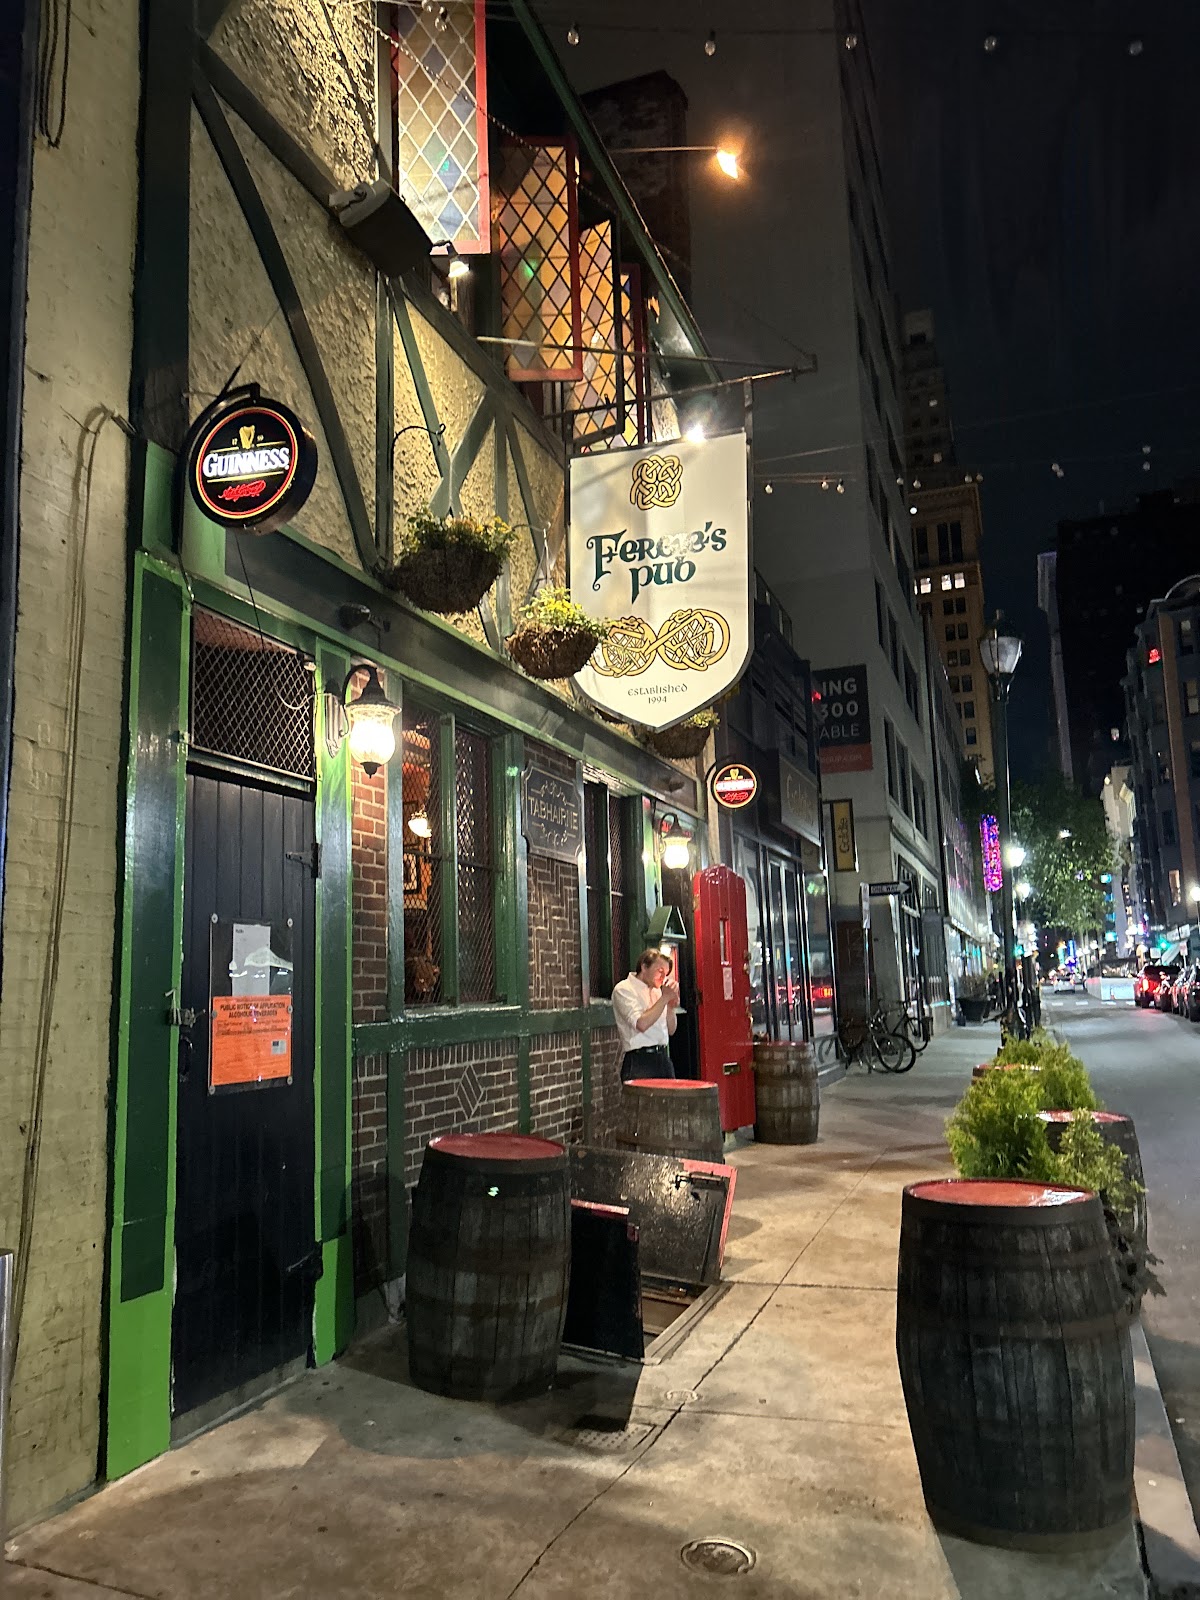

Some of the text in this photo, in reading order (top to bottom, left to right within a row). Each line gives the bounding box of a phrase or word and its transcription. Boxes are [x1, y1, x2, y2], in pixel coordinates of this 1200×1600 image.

[203, 448, 290, 477] GUINNESS
[586, 521, 727, 592] Ferge's
[629, 556, 697, 605] pub
[648, 696, 667, 705] 1994
